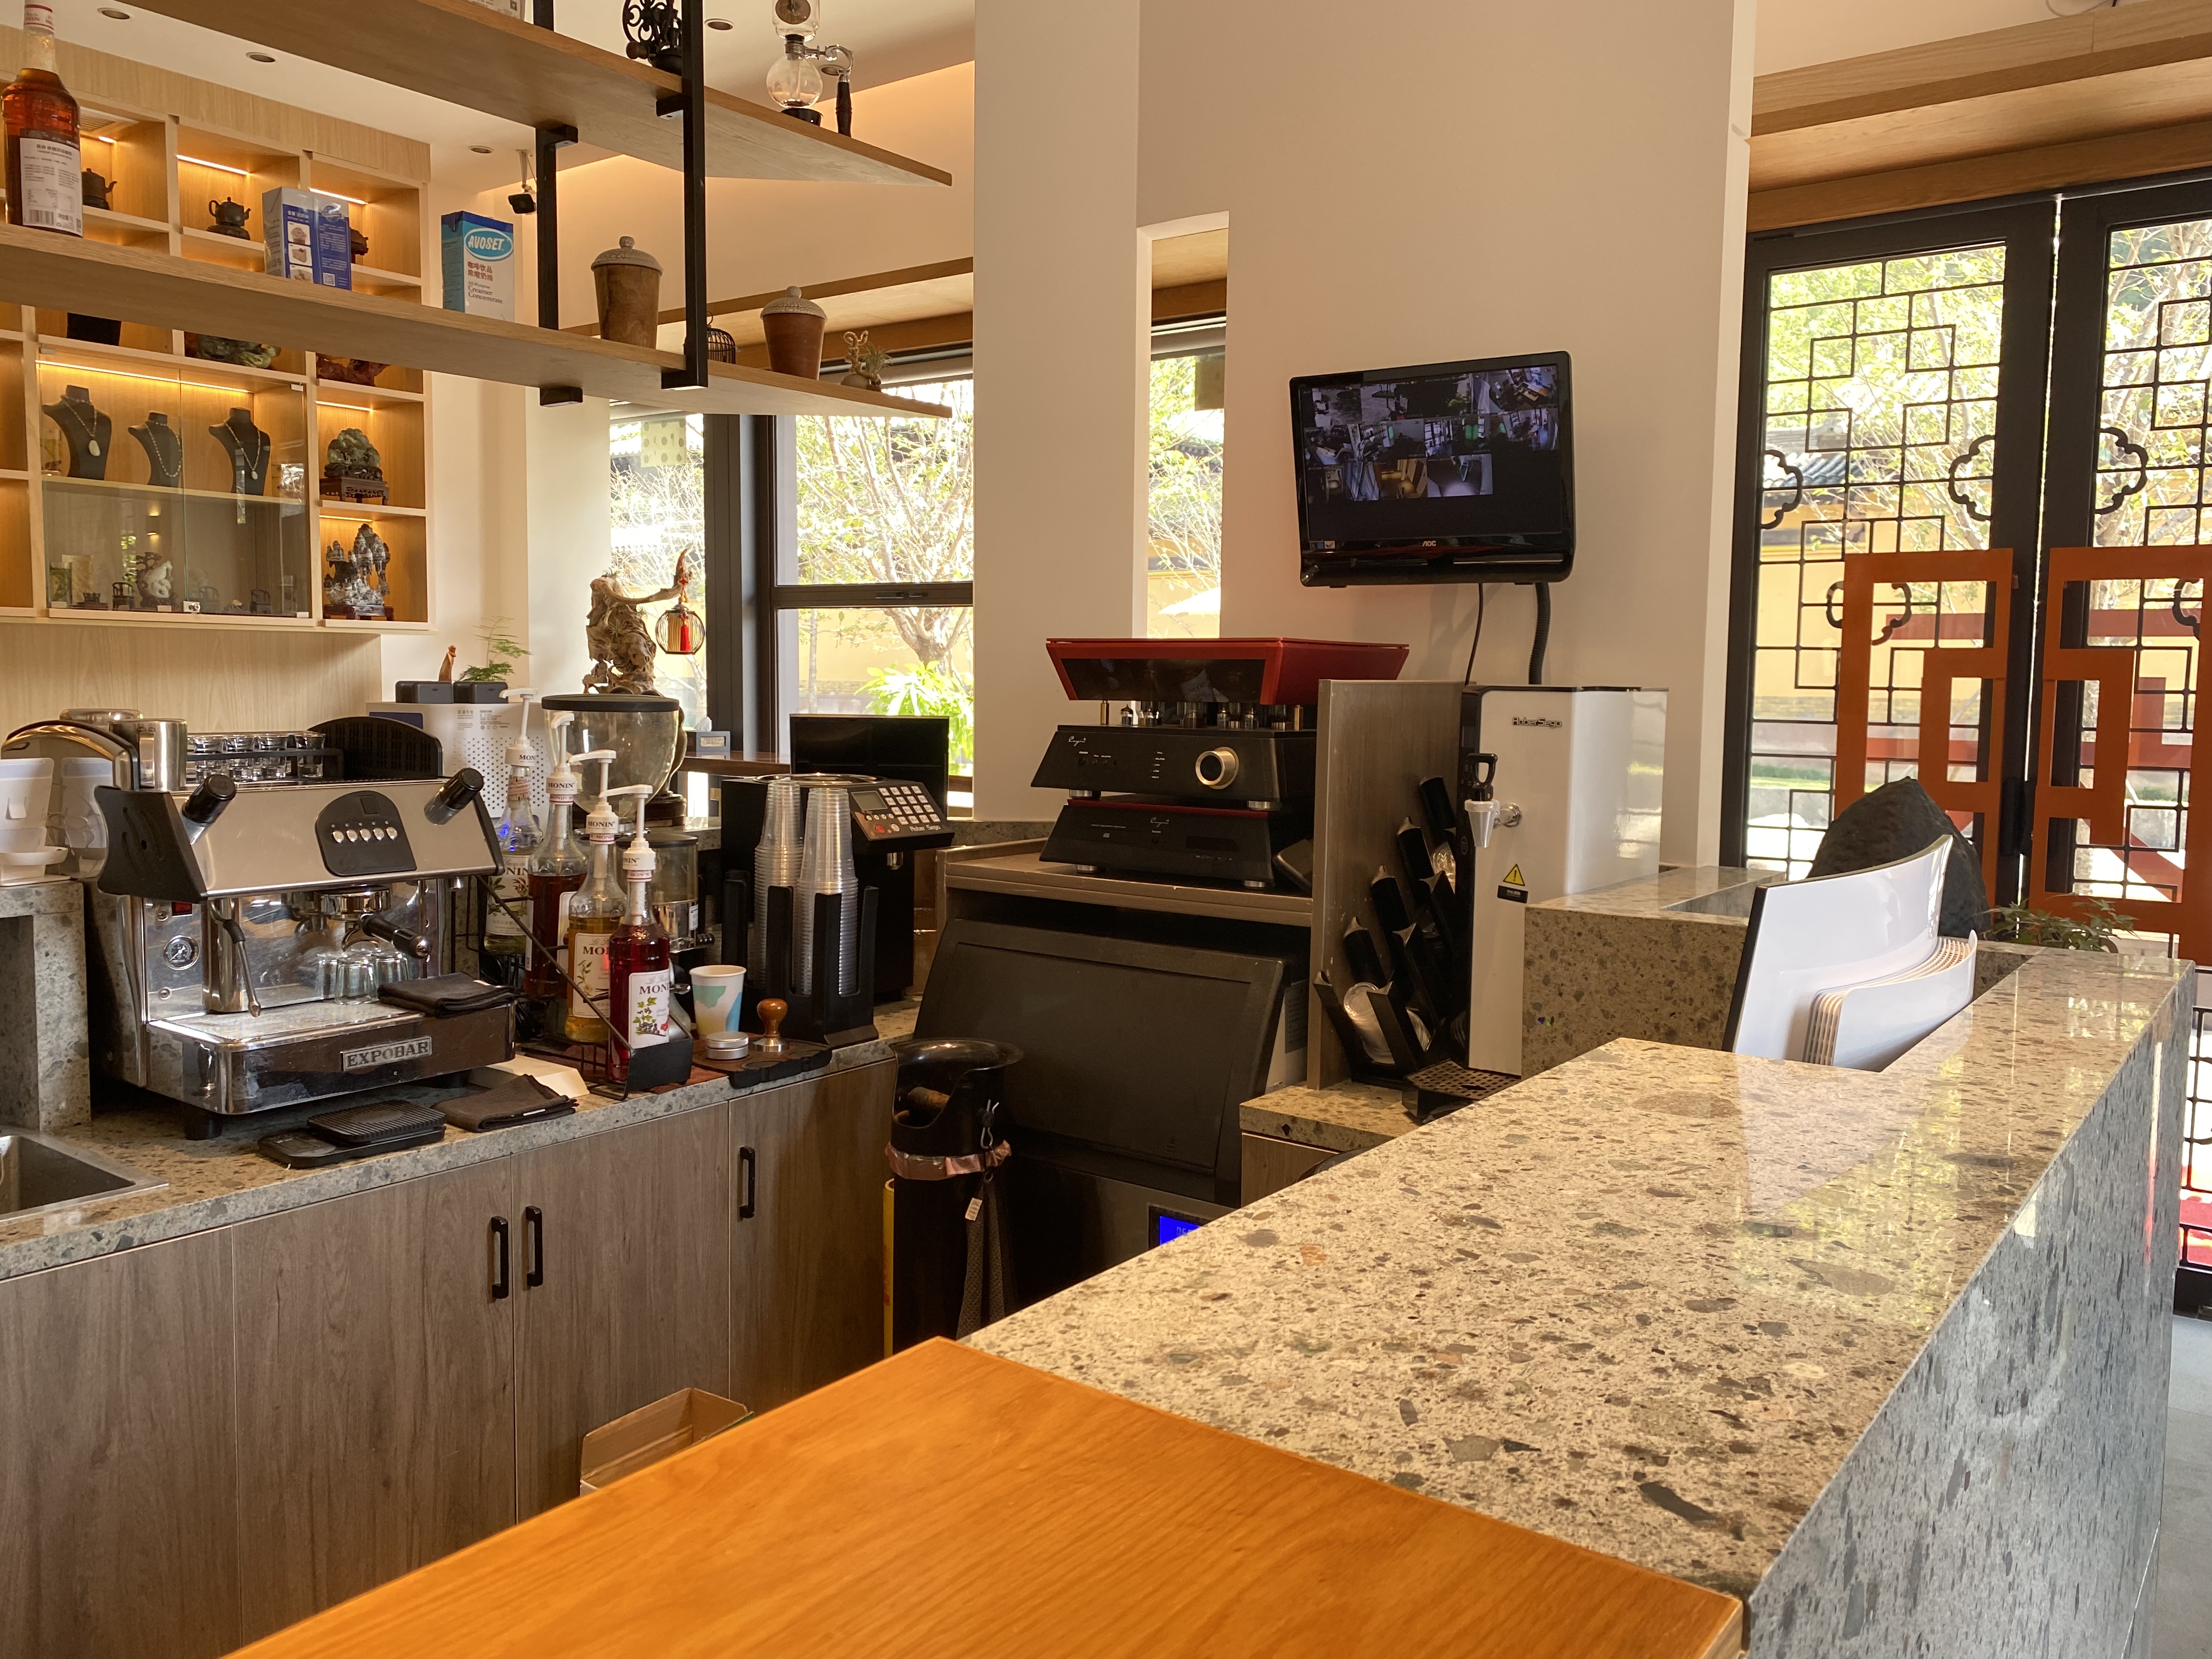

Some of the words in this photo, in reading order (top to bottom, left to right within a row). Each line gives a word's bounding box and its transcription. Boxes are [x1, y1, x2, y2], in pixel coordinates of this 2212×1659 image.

[467, 235, 505, 251] AVOSET
[468, 285, 493, 295] Creamer
[468, 292, 503, 304] Concentrate
[506, 867, 529, 876] NIN
[639, 983, 669, 995] MONI
[347, 1041, 428, 1067] EXPOBAR
